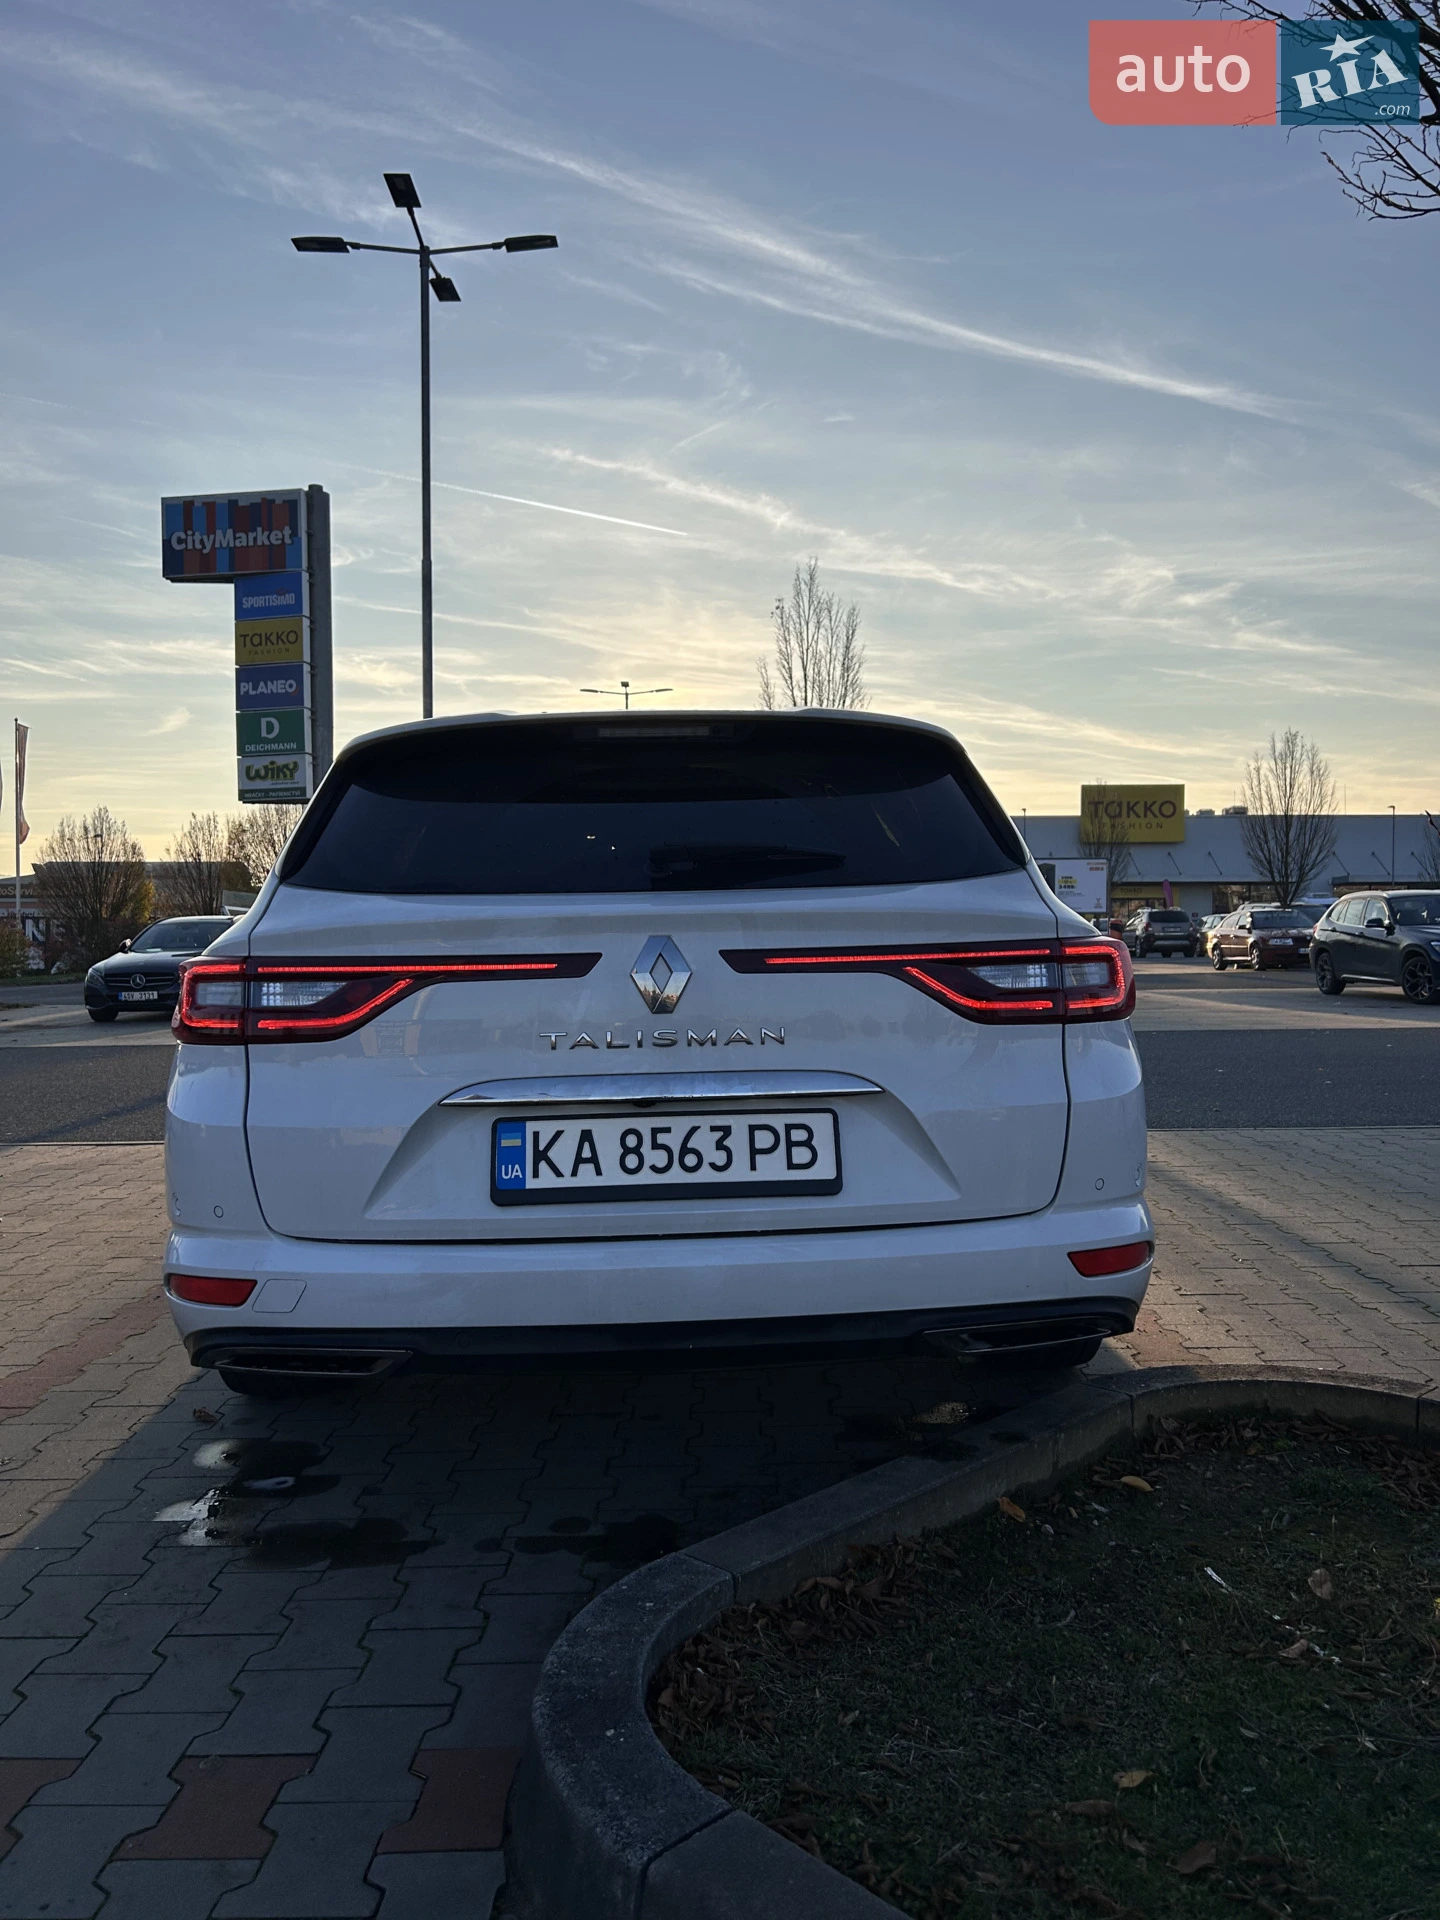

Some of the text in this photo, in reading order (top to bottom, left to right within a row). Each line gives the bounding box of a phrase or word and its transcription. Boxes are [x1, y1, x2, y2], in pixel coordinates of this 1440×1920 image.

[171, 525, 292, 554] CityMarket
[242, 593, 296, 608] SPORTISIMO
[248, 647, 290, 656] FASHION
[240, 679, 297, 696] PLANEO
[260, 717, 280, 739] D
[245, 742, 297, 752] DEICHMANN
[539, 1026, 786, 1051] TALISMAN
[532, 1123, 818, 1179] KA 8563 PB
[501, 1163, 523, 1180] UA
